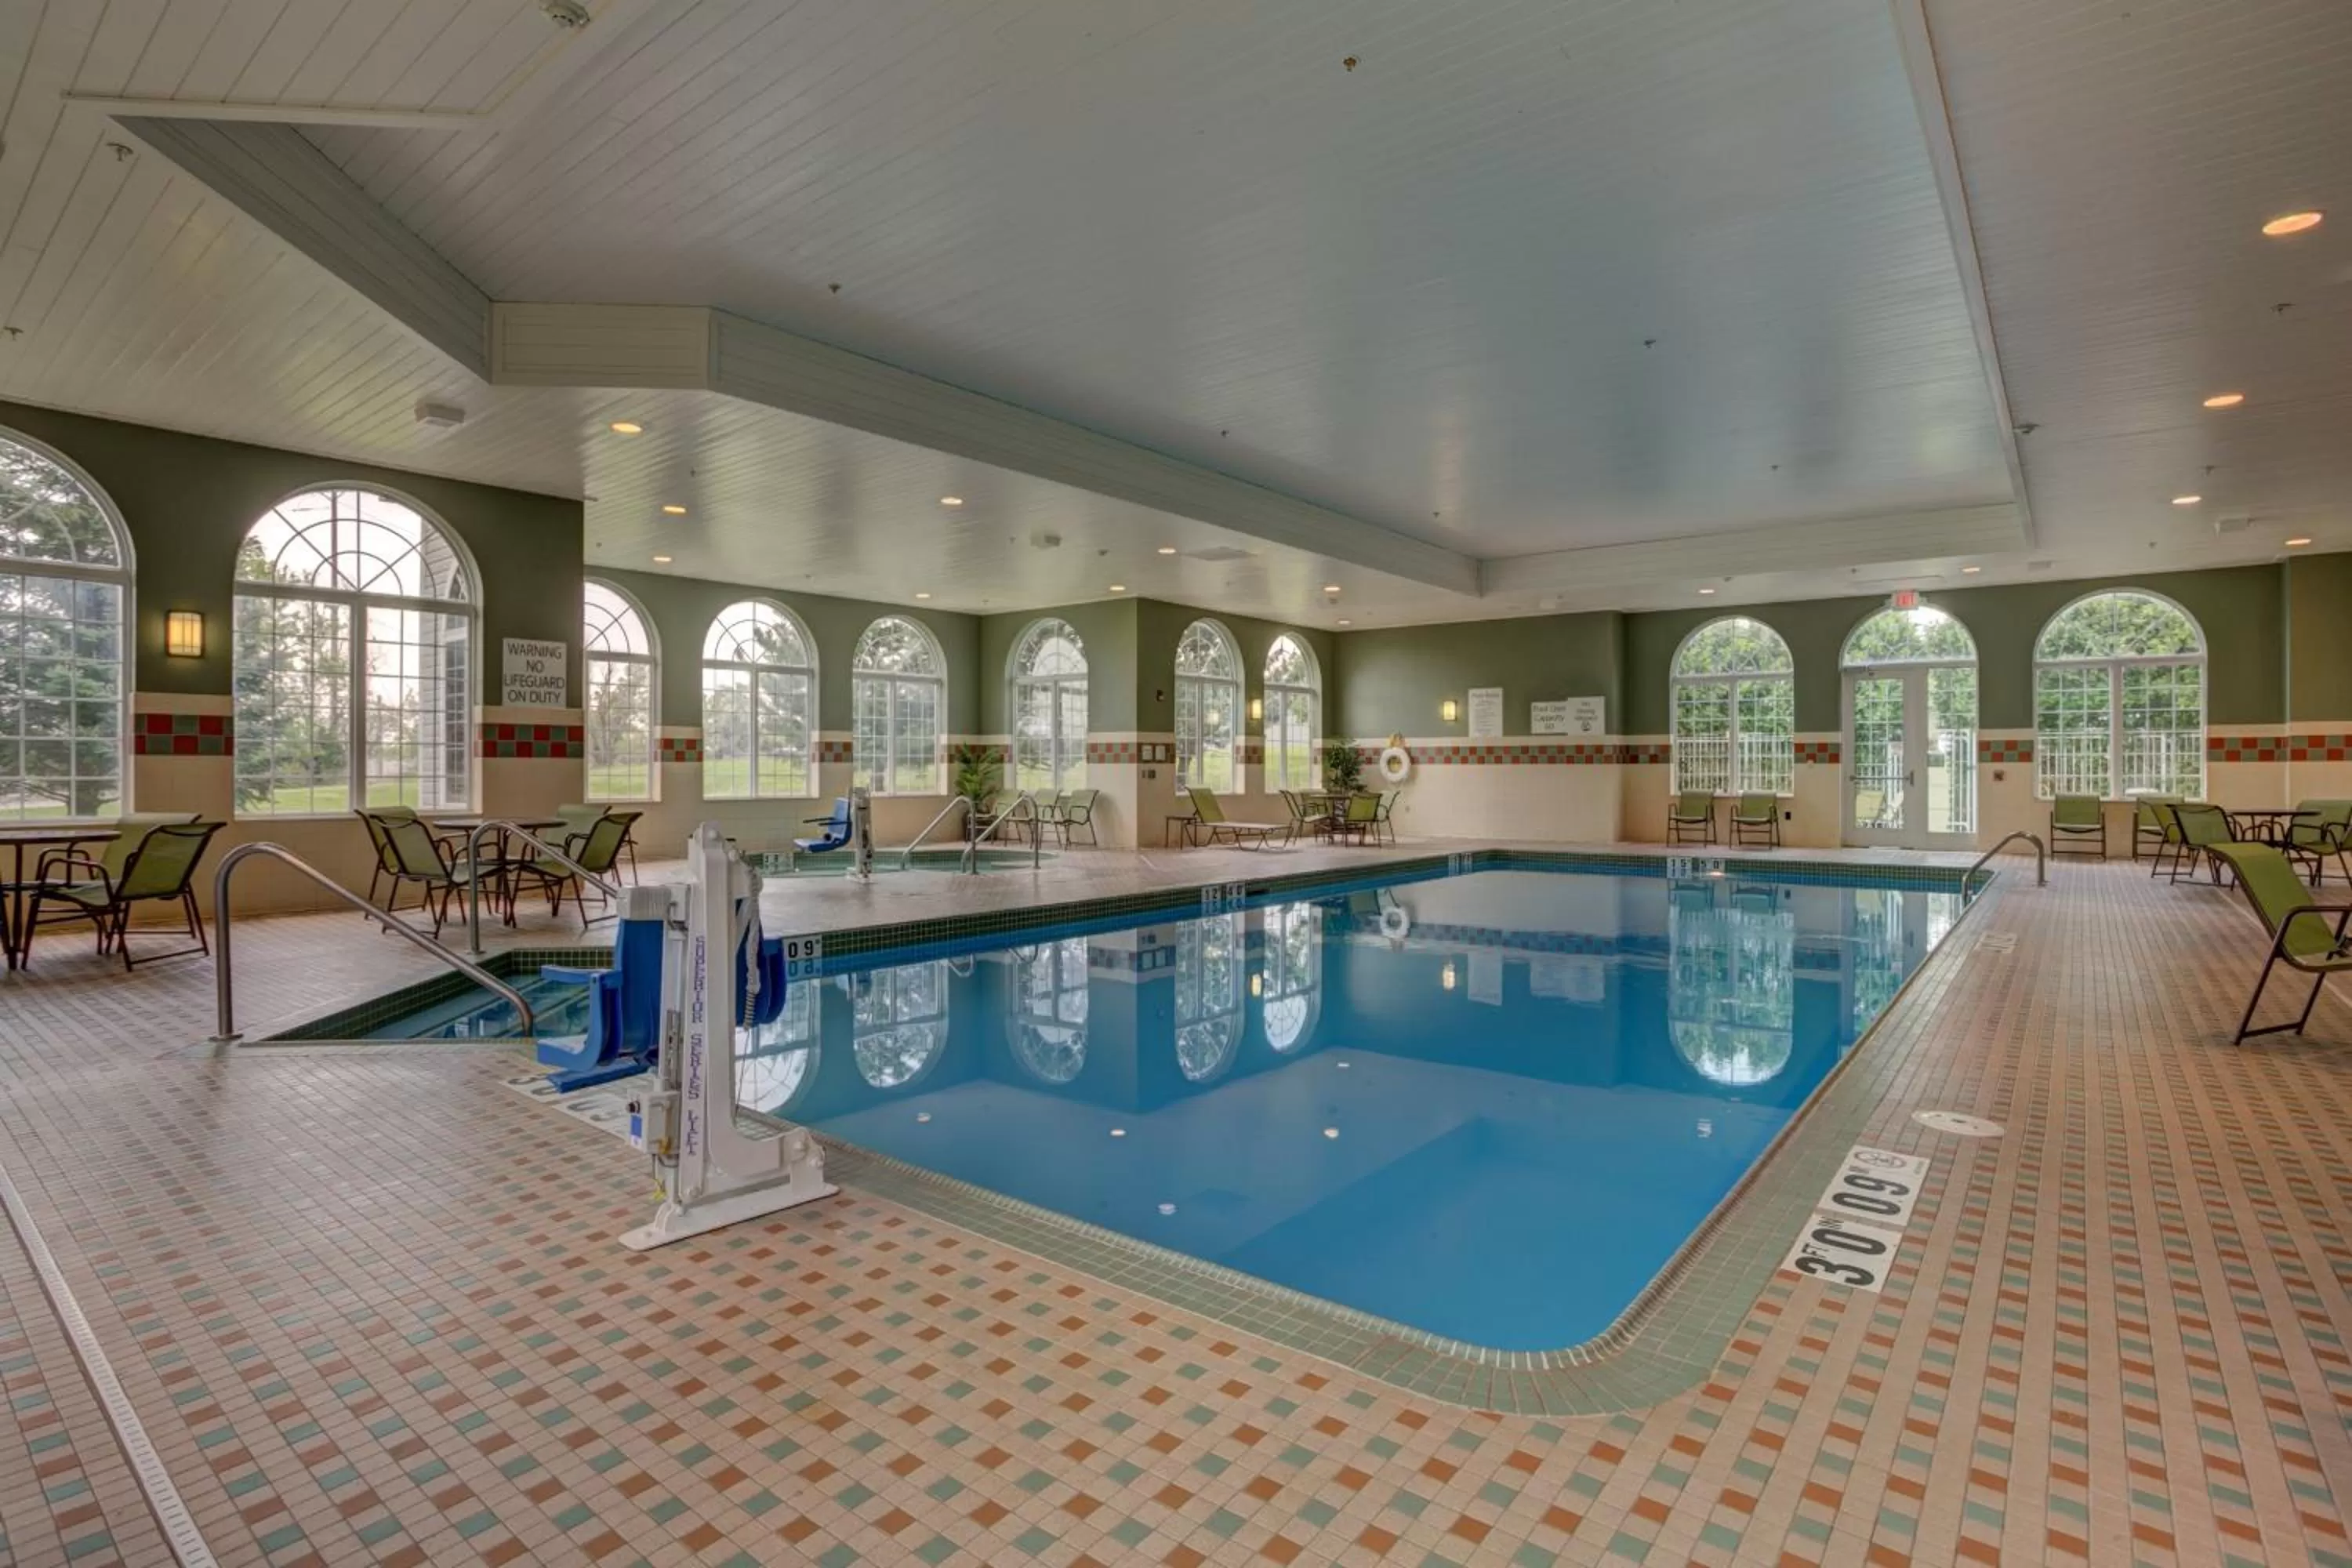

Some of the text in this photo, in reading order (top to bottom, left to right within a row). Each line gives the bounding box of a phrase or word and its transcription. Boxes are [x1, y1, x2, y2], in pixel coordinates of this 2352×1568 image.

[507, 642, 562, 659] WARNING
[525, 659, 545, 673] NO
[504, 674, 565, 689] LIFEGUARD
[507, 690, 561, 703] ON DUTY
[689, 1033, 703, 1100] SERIES
[686, 1109, 699, 1156] LIFT
